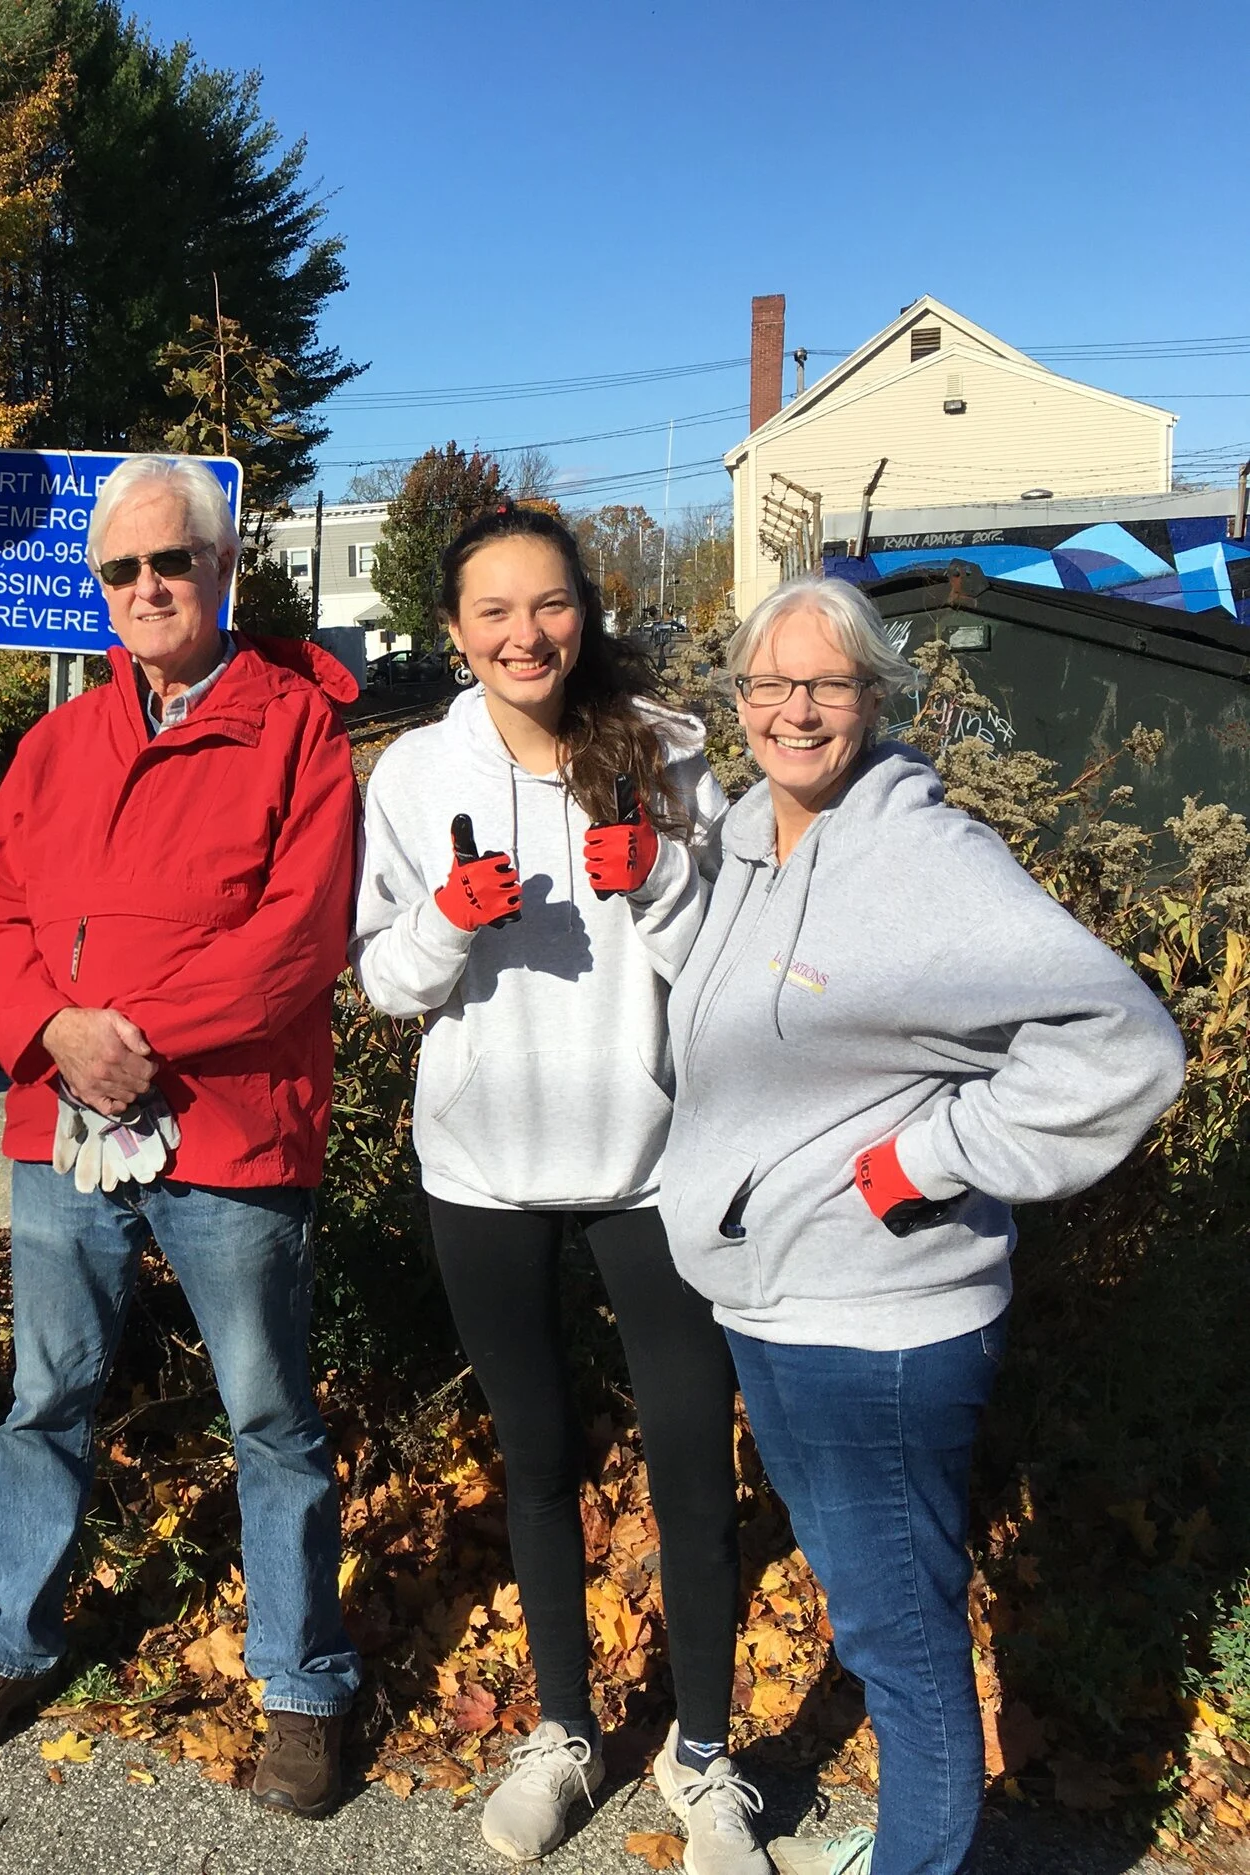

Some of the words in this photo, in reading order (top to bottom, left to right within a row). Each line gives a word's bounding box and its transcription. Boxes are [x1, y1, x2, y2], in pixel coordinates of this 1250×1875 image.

[883, 535, 919, 550] RYAN
[921, 533, 965, 546] ADAMS
[78, 576, 94, 599] #
